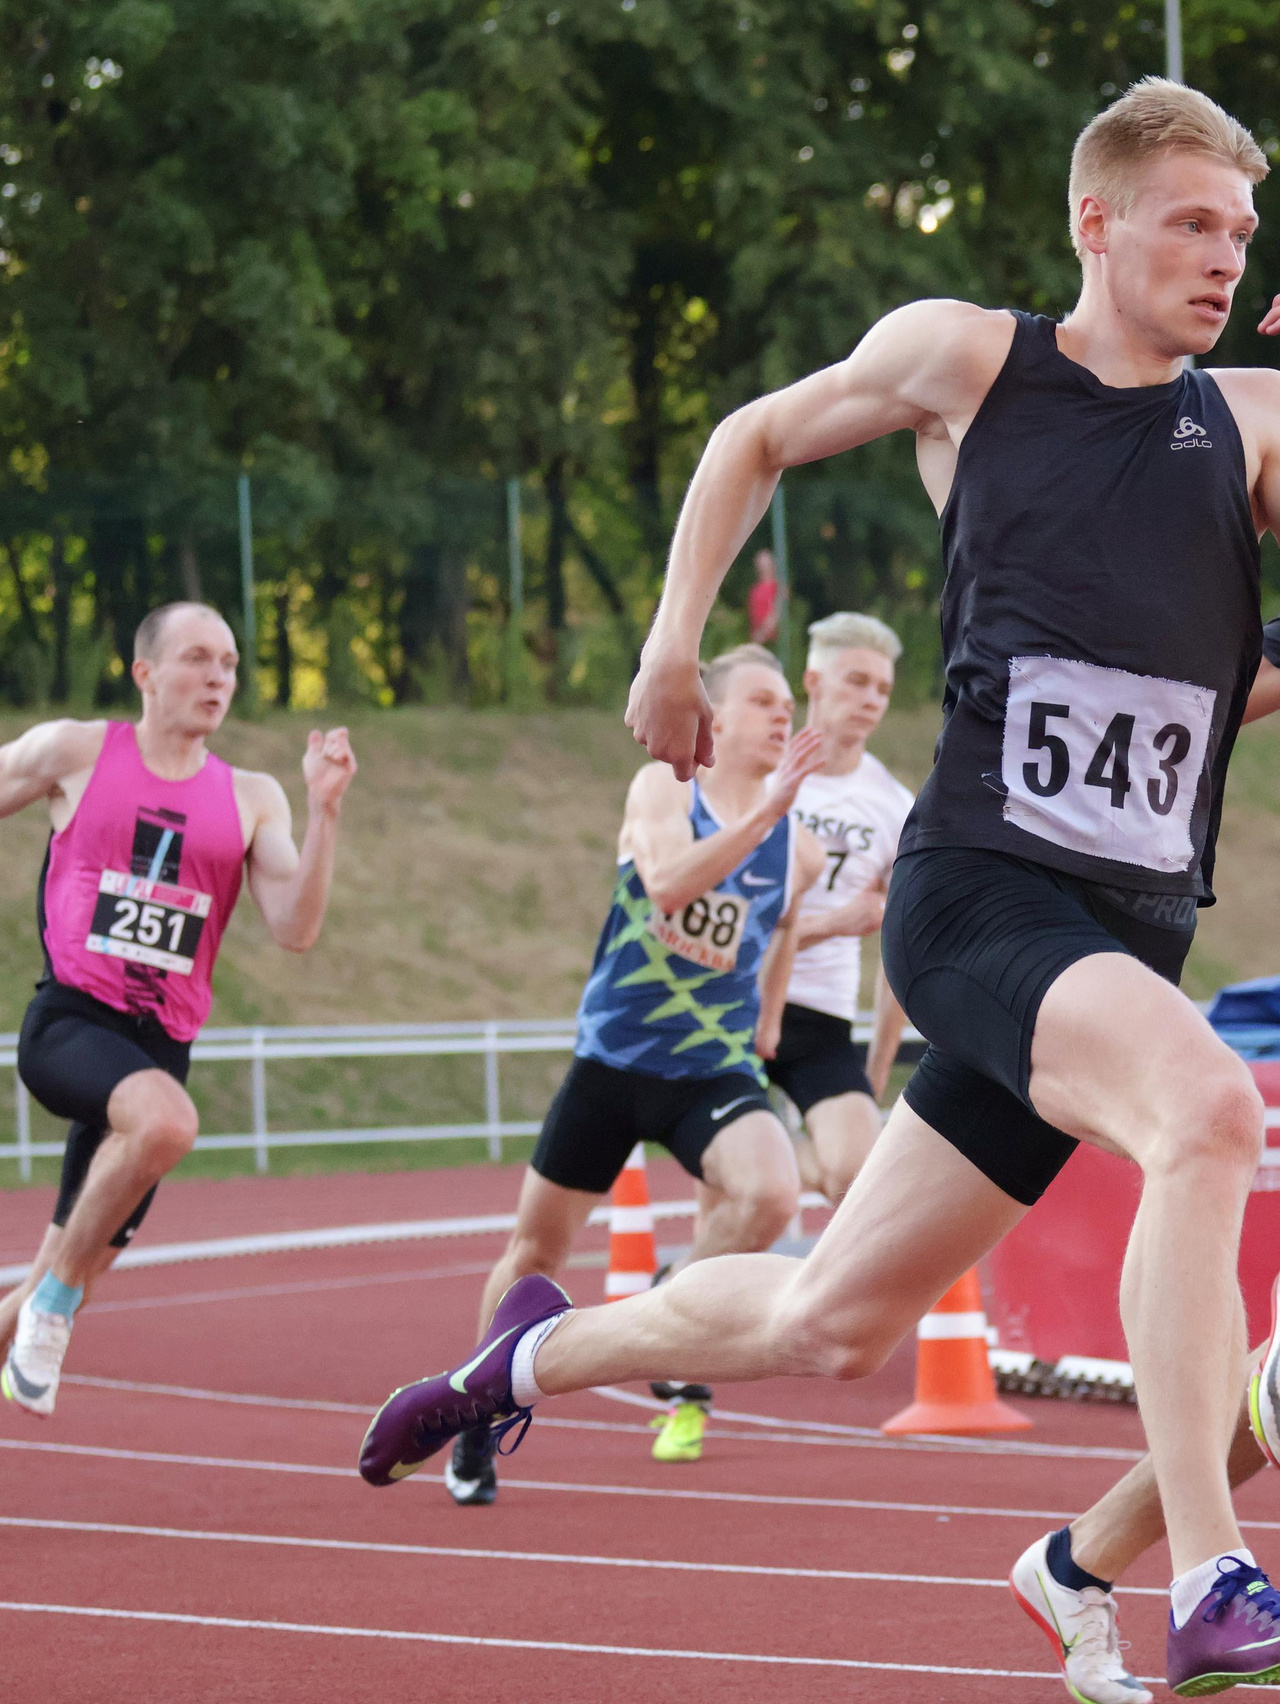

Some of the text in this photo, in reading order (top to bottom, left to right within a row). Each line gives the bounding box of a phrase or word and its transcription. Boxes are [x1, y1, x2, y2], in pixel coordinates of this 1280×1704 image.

[1170, 438, 1213, 451] odlo
[1021, 701, 1192, 816] 543
[108, 899, 187, 953] 251
